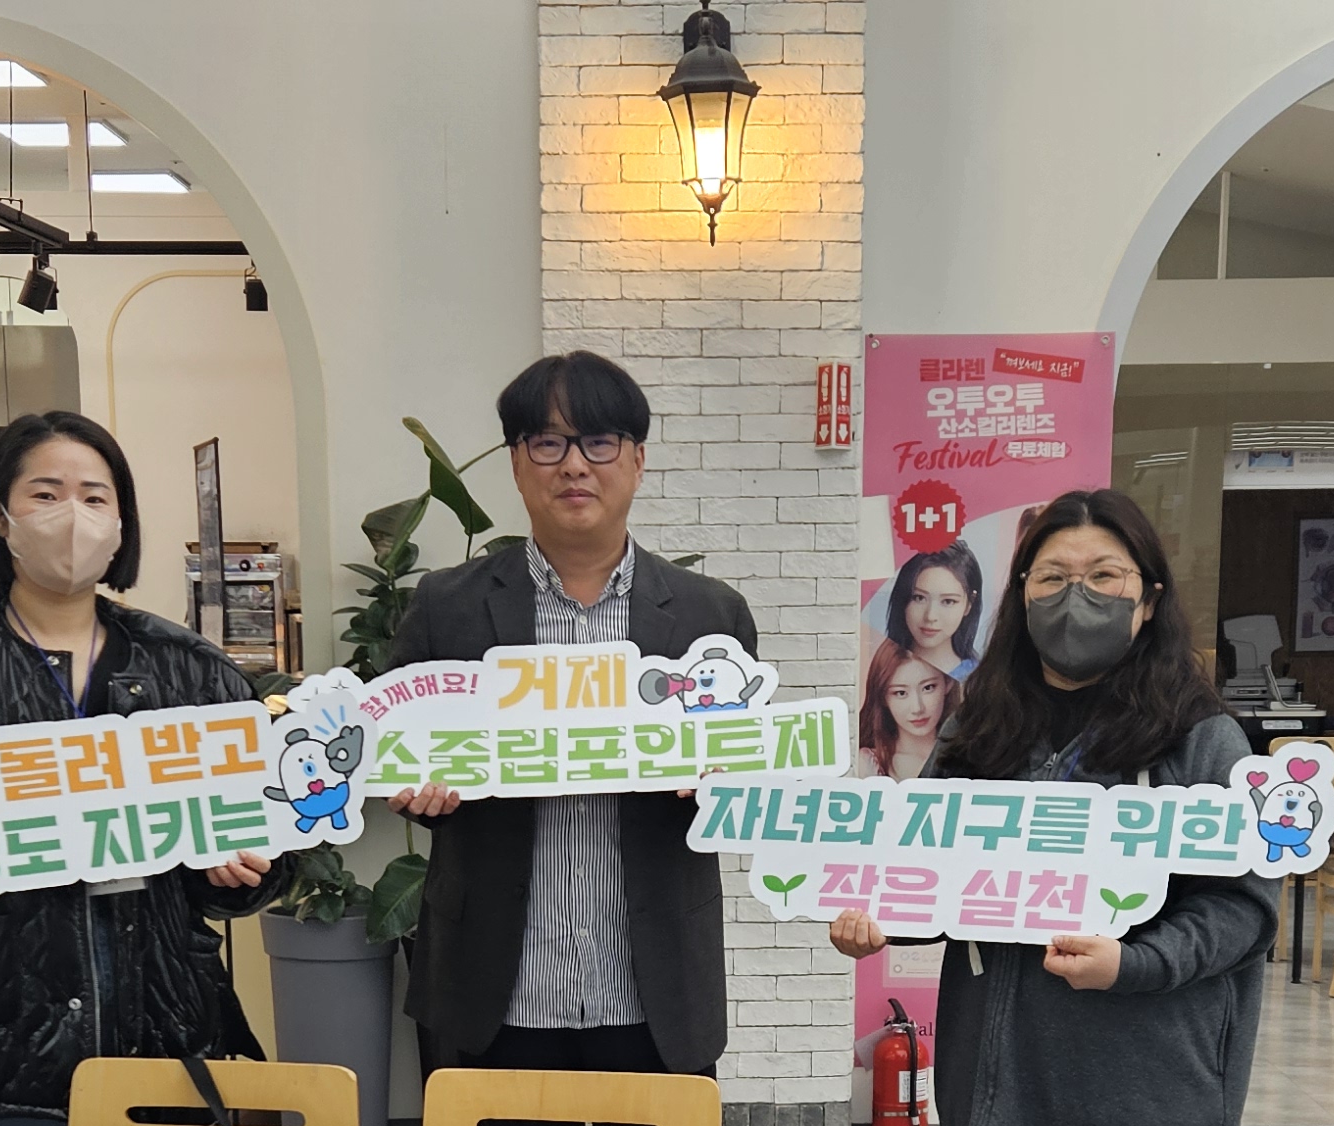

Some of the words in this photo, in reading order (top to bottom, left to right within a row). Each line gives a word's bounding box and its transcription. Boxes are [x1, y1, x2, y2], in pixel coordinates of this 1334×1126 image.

[920, 358, 986, 382] 클라렌
[926, 383, 1045, 417] 오투오투
[937, 413, 1056, 439] 산소컬러렌즈
[893, 438, 1008, 474] Festival
[1006, 441, 1067, 459] 무료체험
[900, 502, 957, 533] 1+1
[359, 672, 479, 722] 함께해요!
[497, 653, 628, 711] 거제
[139, 715, 267, 786] 받고
[81, 794, 271, 869] 지키는
[699, 785, 884, 843] 자녀와
[898, 792, 1093, 855] 지구를
[1109, 799, 1247, 861] 위한
[816, 863, 941, 923] 작은
[957, 866, 1091, 932] 실천
